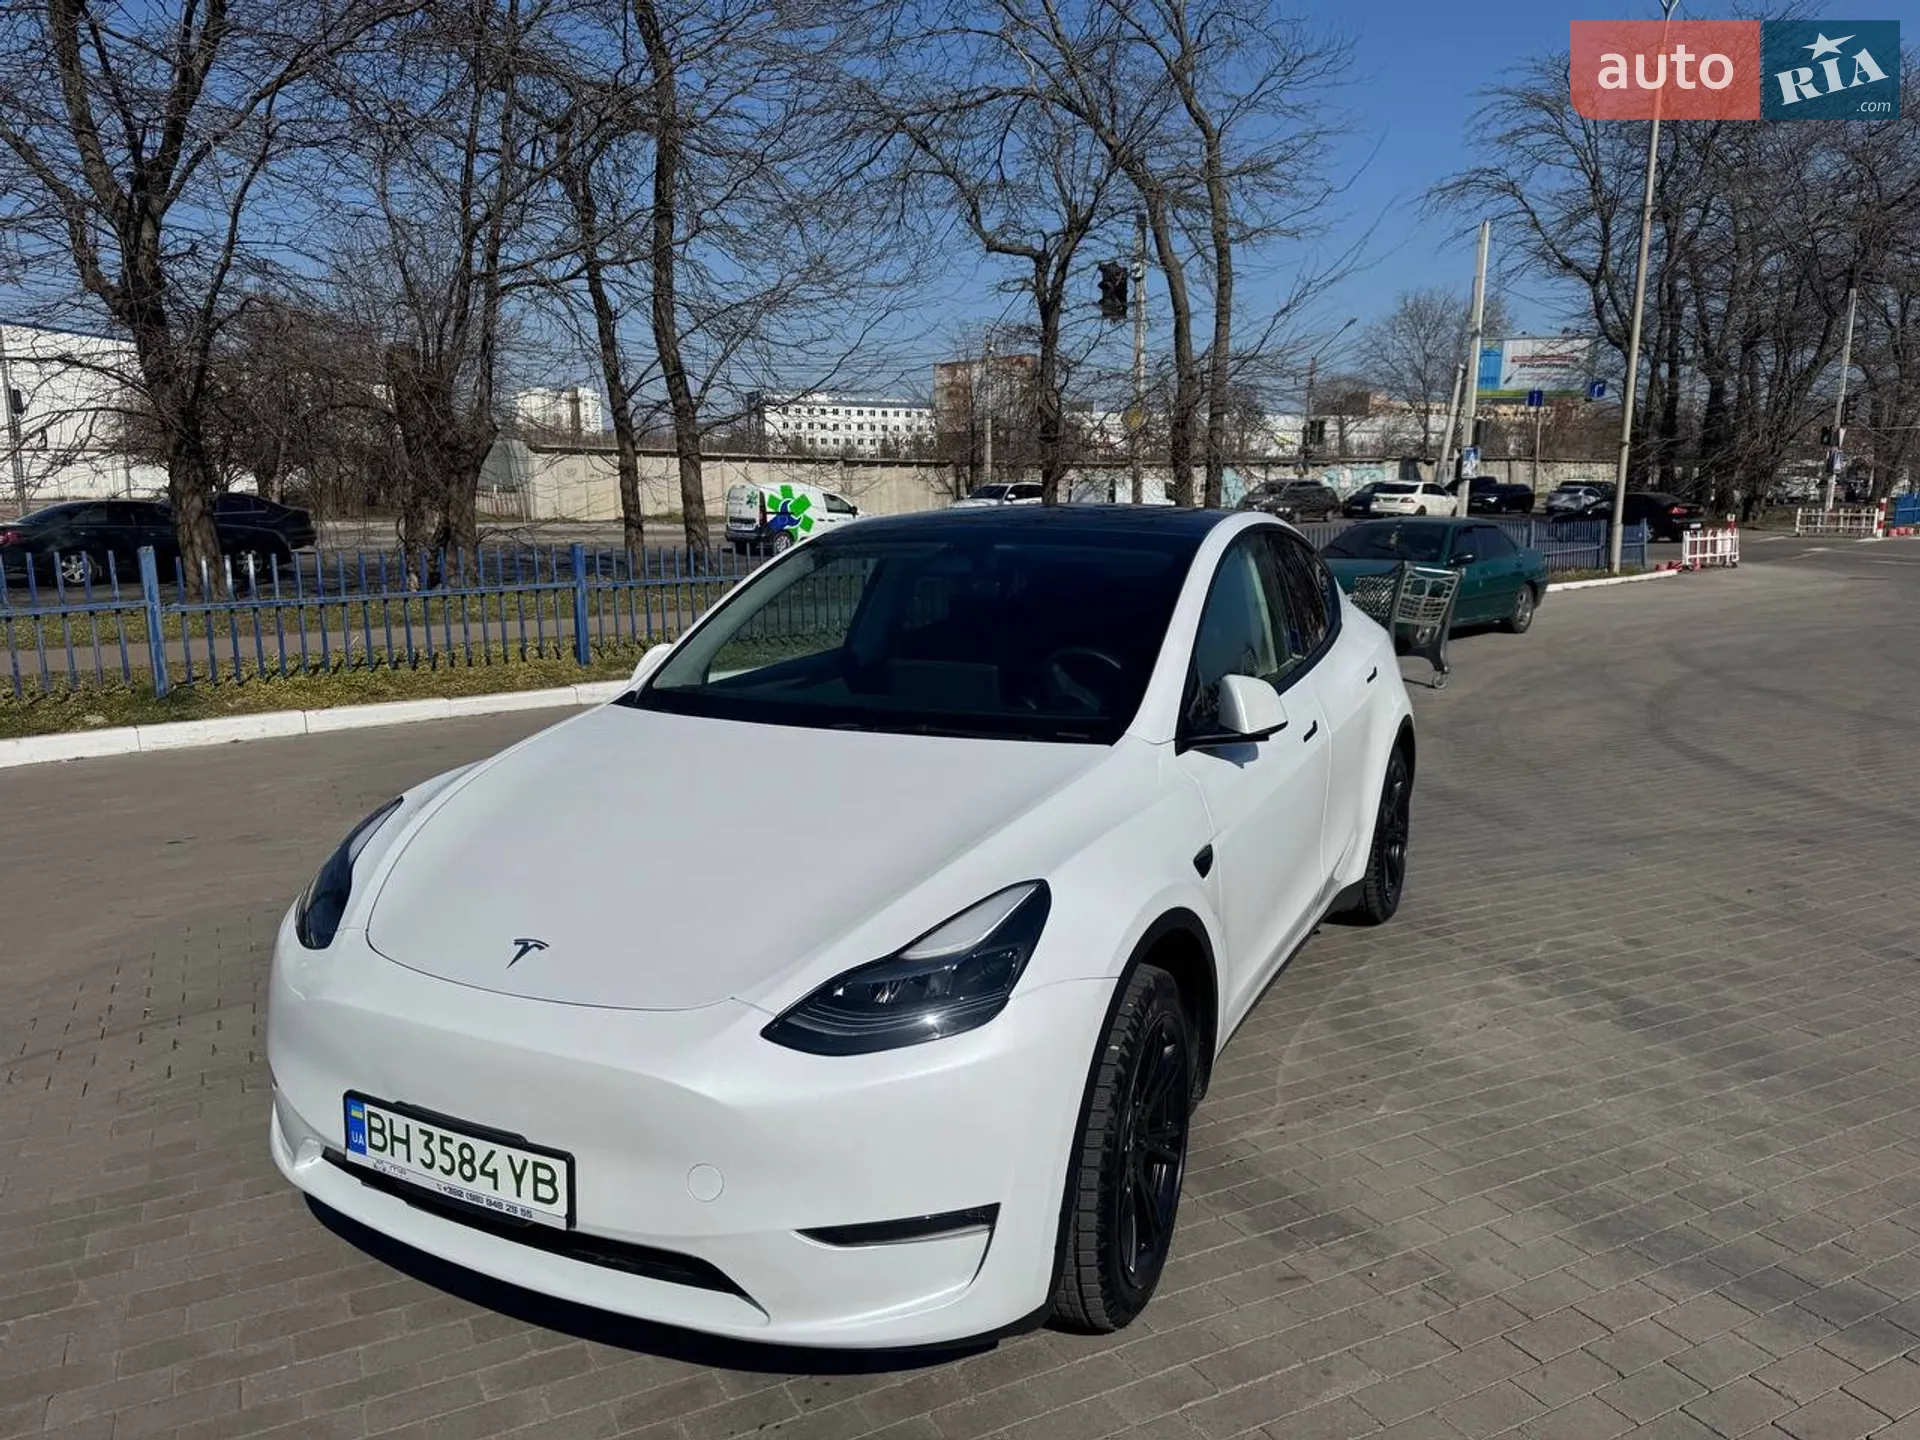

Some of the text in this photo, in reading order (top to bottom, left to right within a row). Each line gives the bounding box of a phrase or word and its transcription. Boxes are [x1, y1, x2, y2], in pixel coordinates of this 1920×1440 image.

[352, 1133, 365, 1146] UA
[367, 1110, 560, 1205] BH 3584 YB
